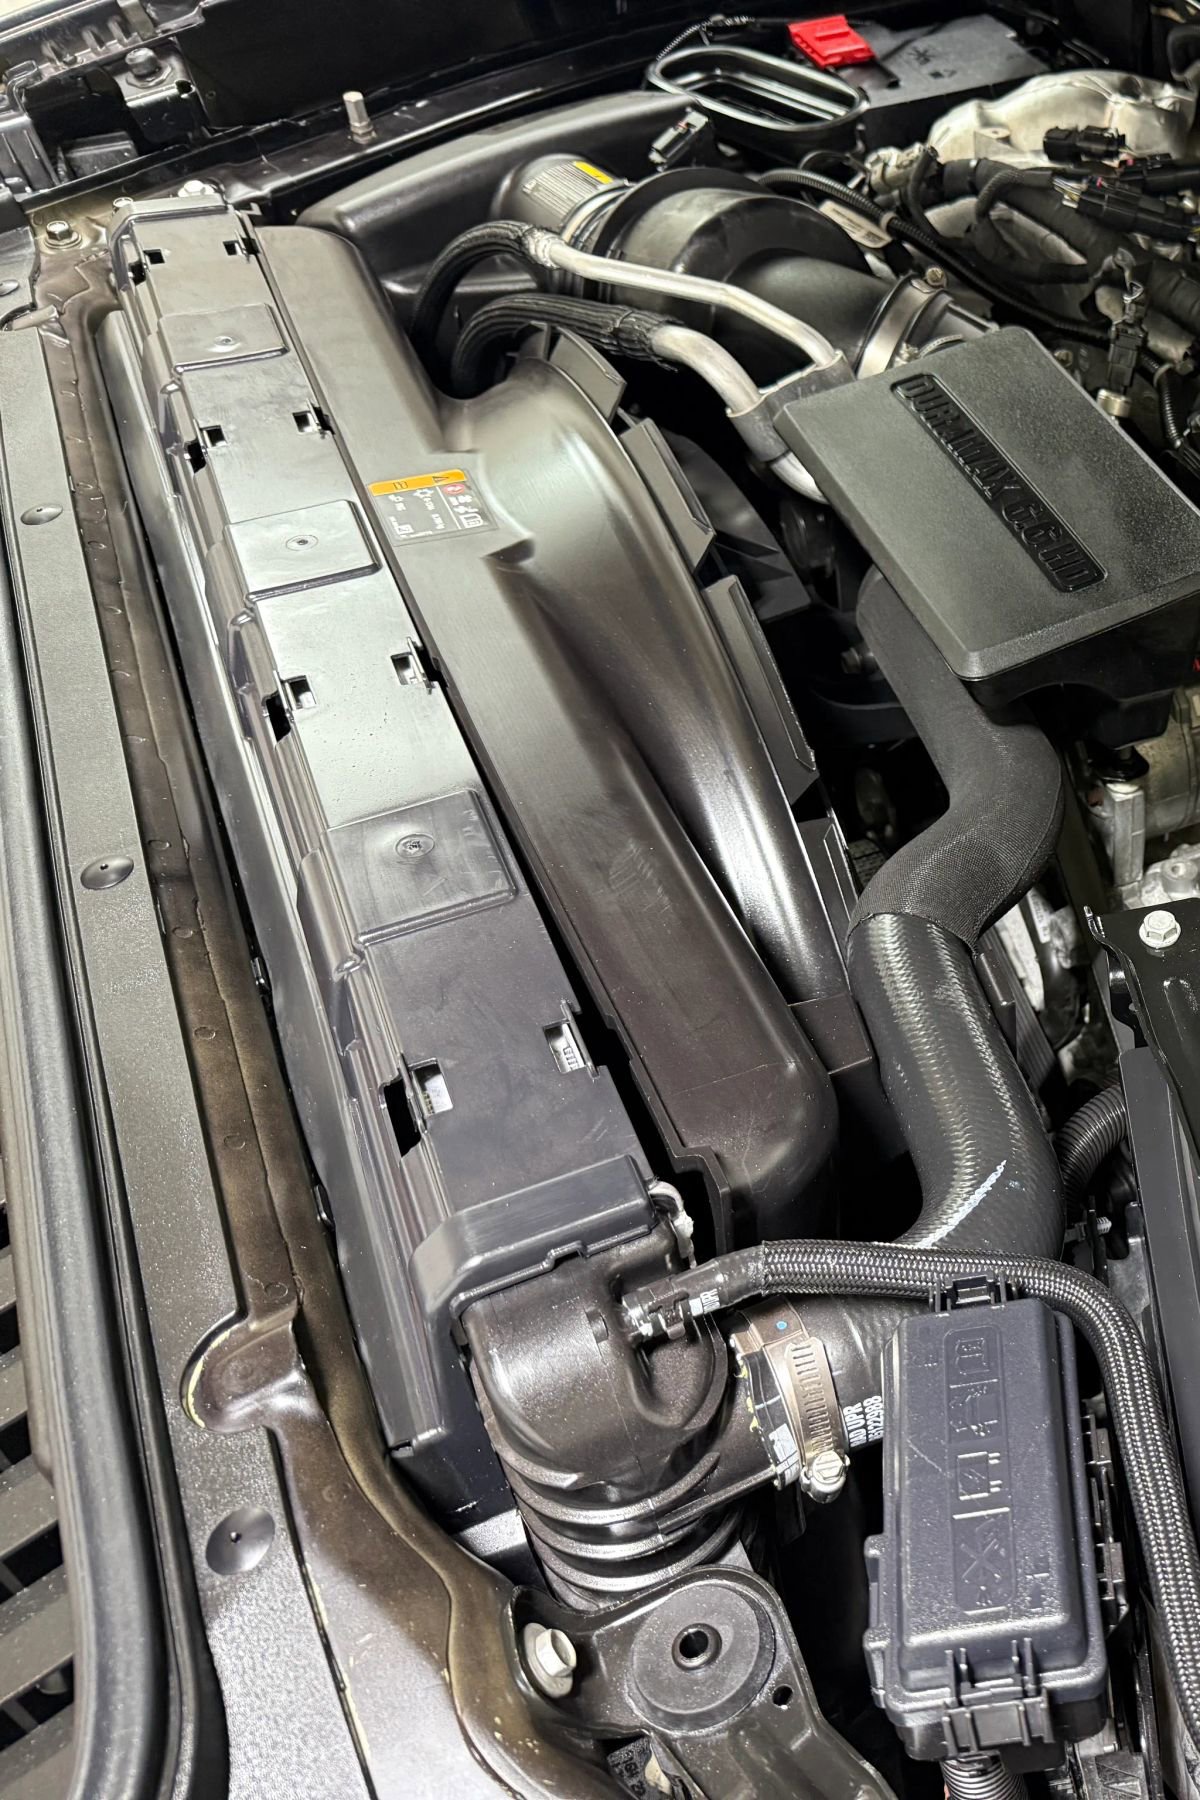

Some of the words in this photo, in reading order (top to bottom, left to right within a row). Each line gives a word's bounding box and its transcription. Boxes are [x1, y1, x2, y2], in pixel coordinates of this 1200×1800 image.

[900, 376, 1022, 500] DURAMAX
[1003, 499, 1063, 550] 6.6
[1039, 543, 1102, 588] HD
[843, 1402, 865, 1431] UPR
